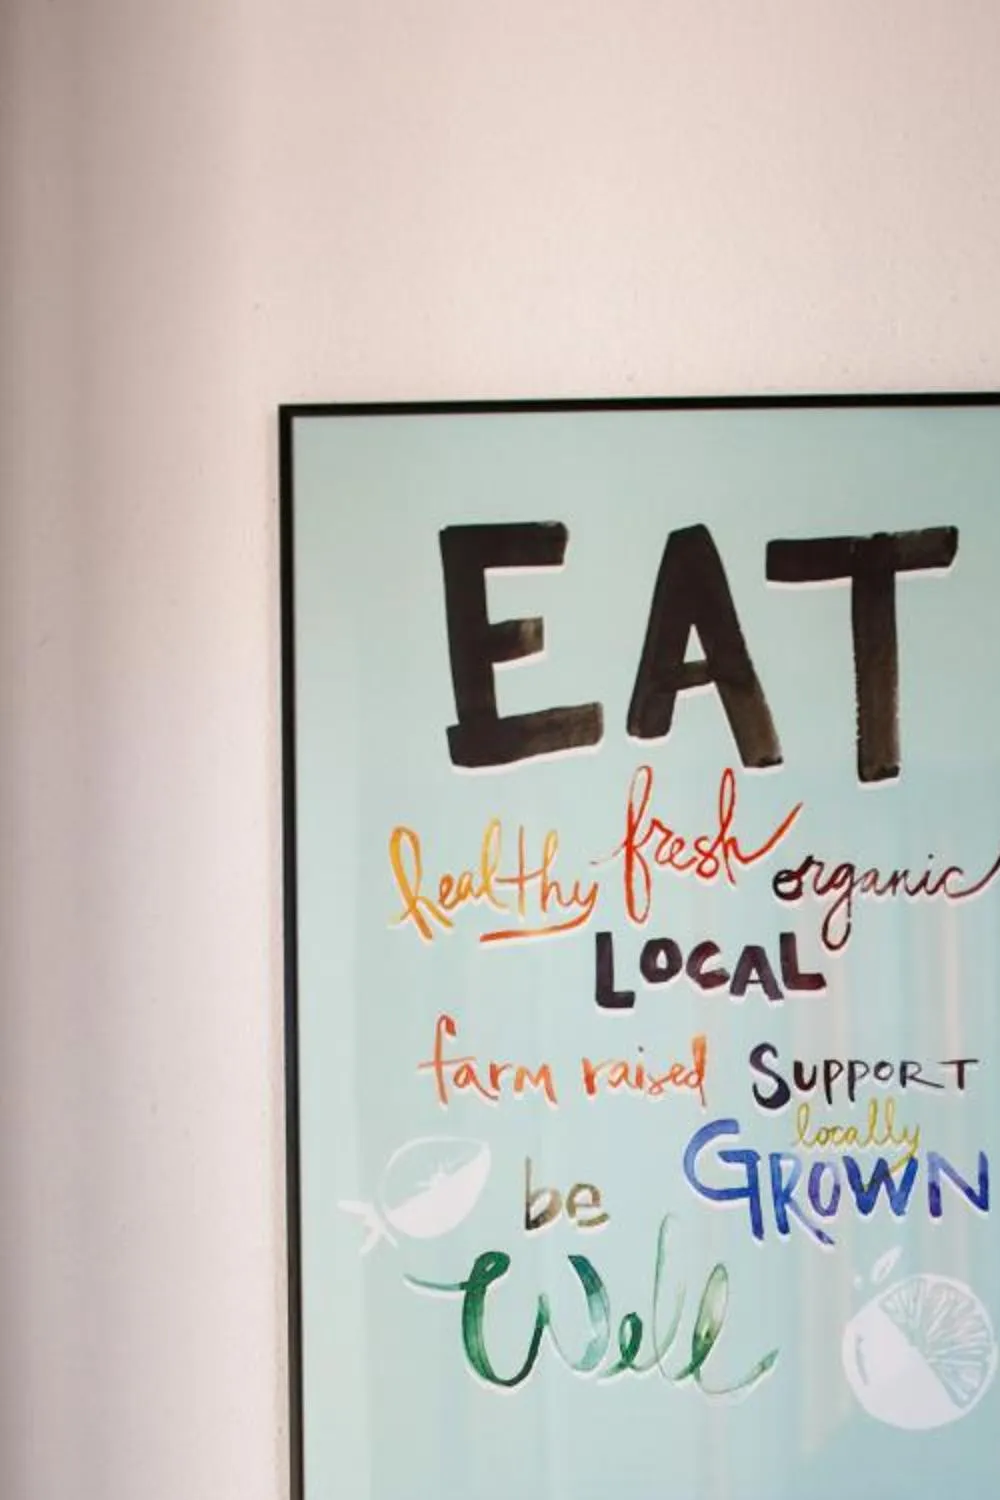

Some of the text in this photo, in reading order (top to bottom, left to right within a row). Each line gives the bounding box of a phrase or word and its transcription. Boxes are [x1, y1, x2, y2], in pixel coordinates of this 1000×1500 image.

[439, 522, 958, 784] EAT
[389, 816, 599, 942] healthy
[597, 766, 803, 922] fresh
[596, 932, 827, 1008] LOCAL
[418, 1015, 707, 1105] farm raised
[749, 1043, 979, 1109] SUPPORT
[796, 1102, 921, 1172] locally
[523, 1156, 609, 1230] be
[683, 1118, 991, 1244] GROWN
